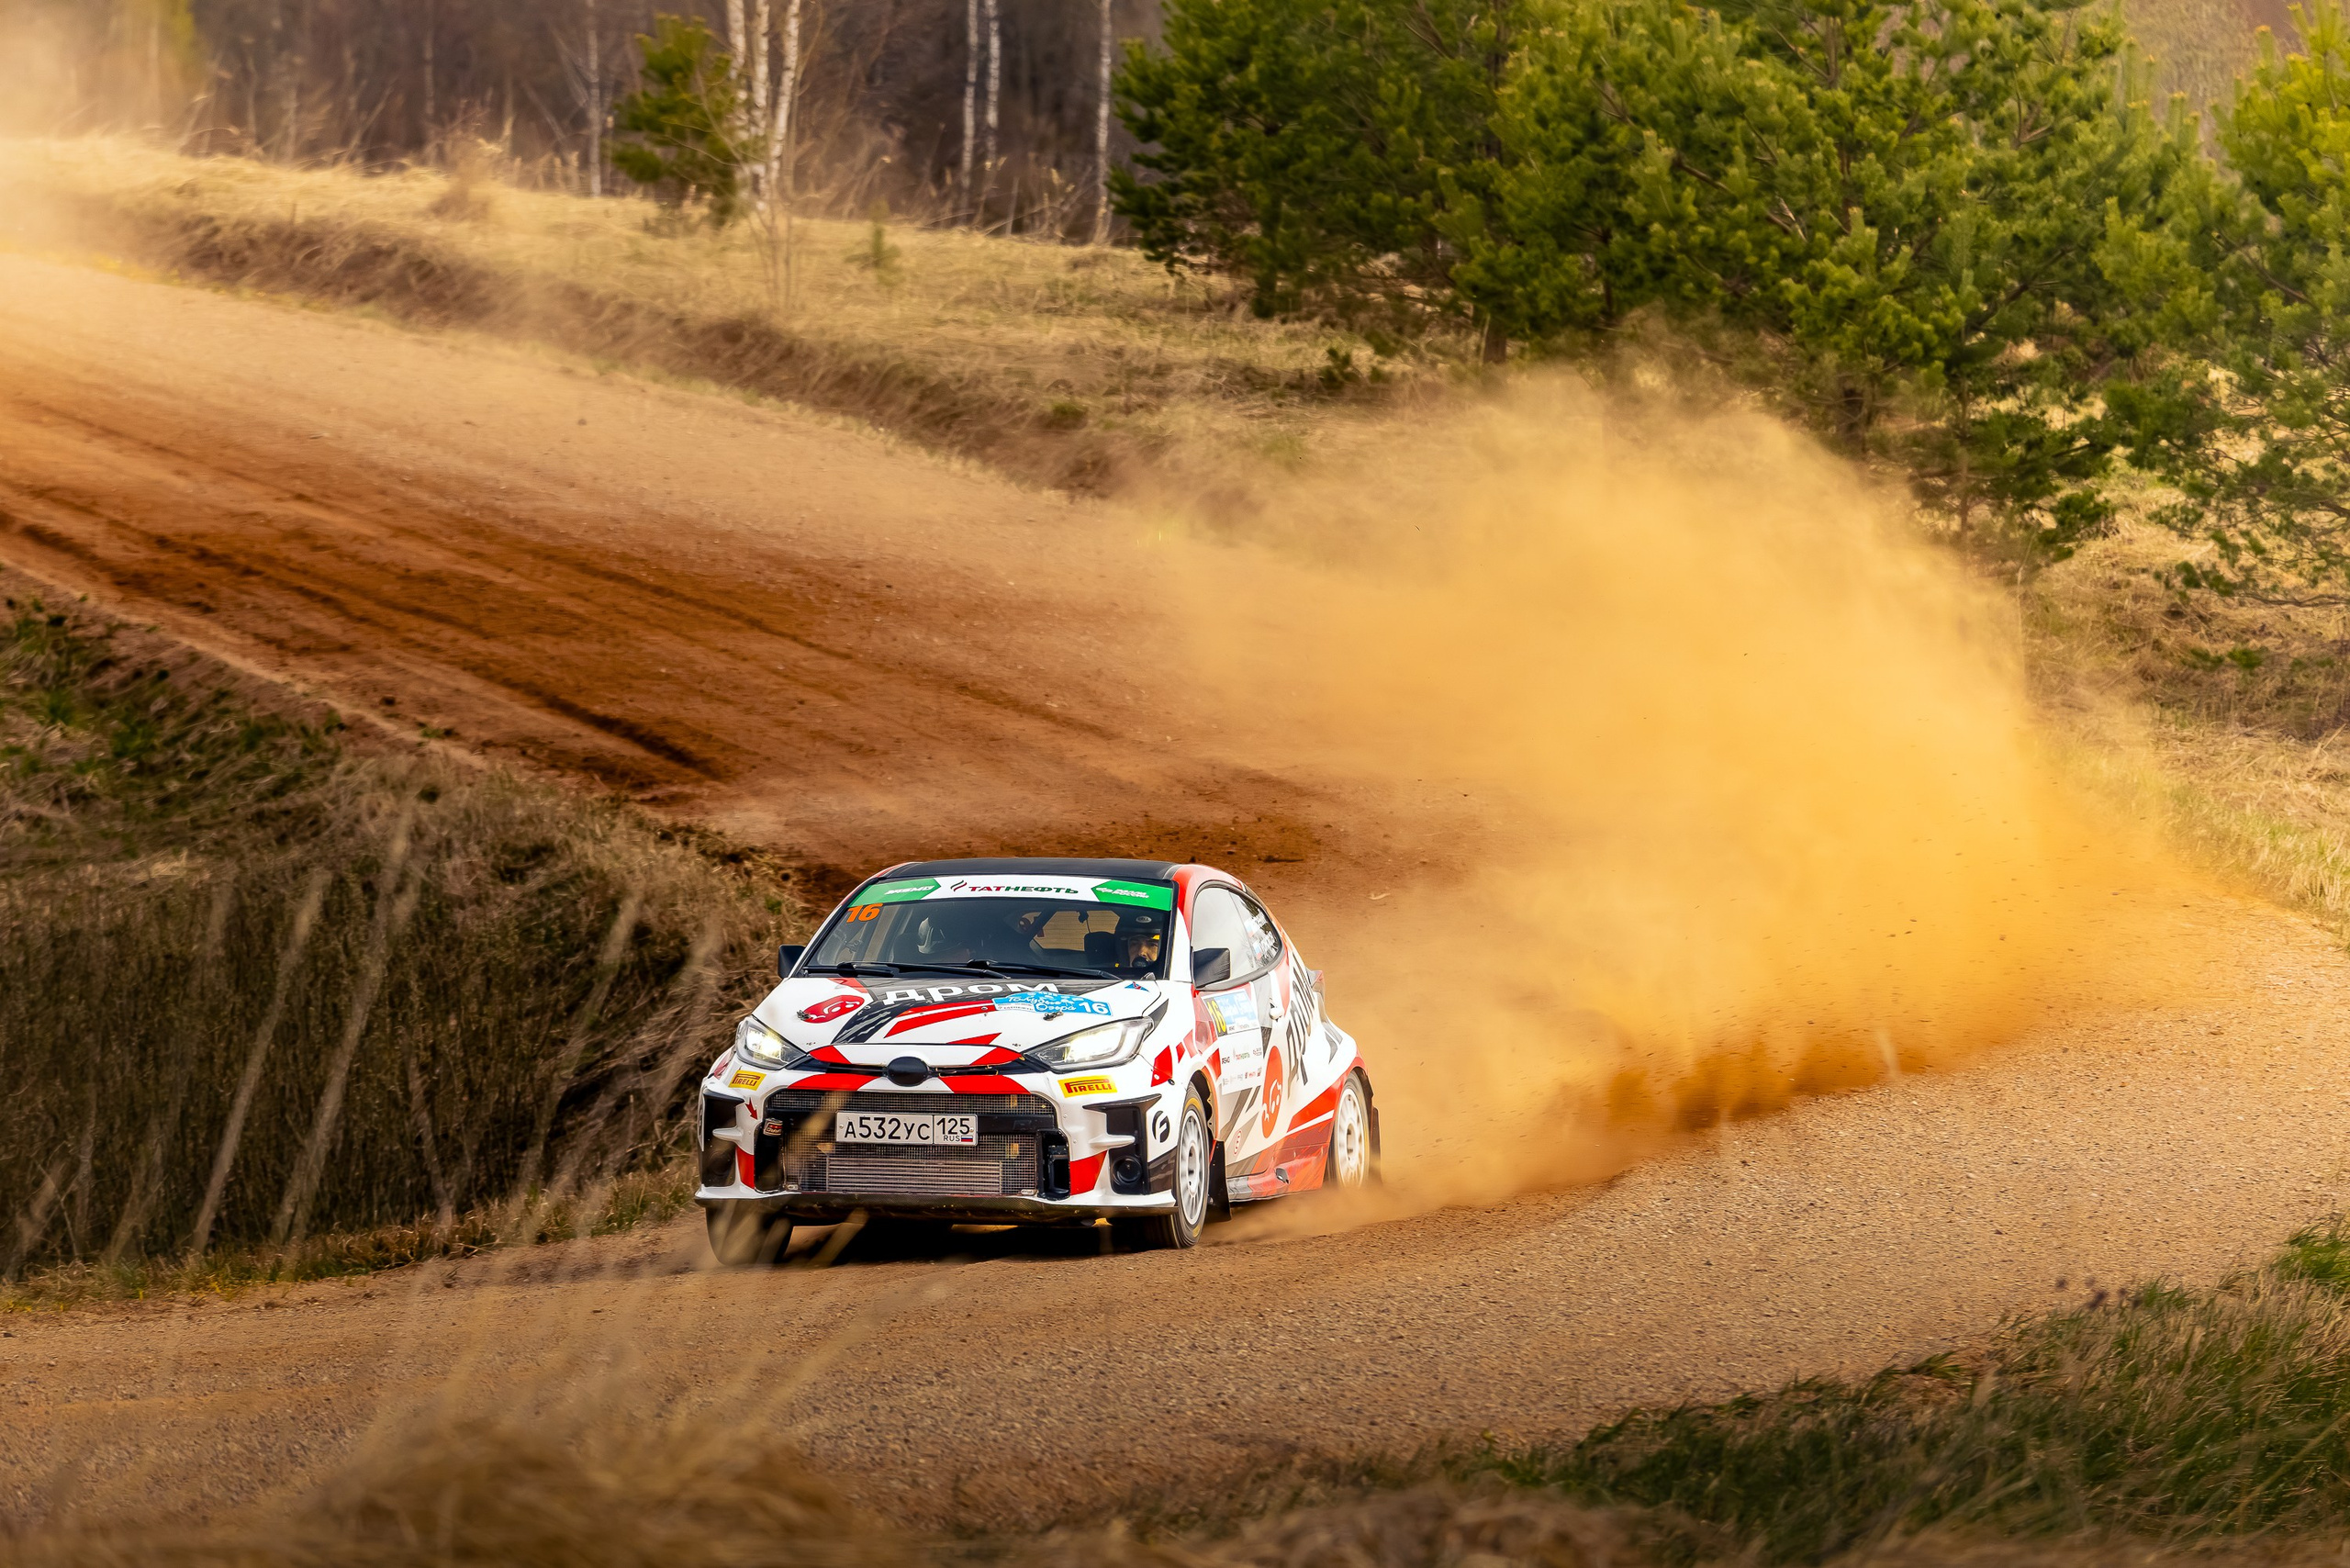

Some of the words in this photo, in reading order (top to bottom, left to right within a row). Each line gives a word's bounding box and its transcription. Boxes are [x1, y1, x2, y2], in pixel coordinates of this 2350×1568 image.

[968, 885, 1079, 894] ТАТНЕФТЬ
[845, 902, 884, 924] 16
[1079, 1002, 1110, 1014] 16
[1206, 999, 1227, 1034] 16
[732, 1073, 761, 1087] PIRELLI
[1064, 1078, 1113, 1093] PIRELLI
[844, 1116, 931, 1140] А532УС
[936, 1117, 970, 1135] 125
